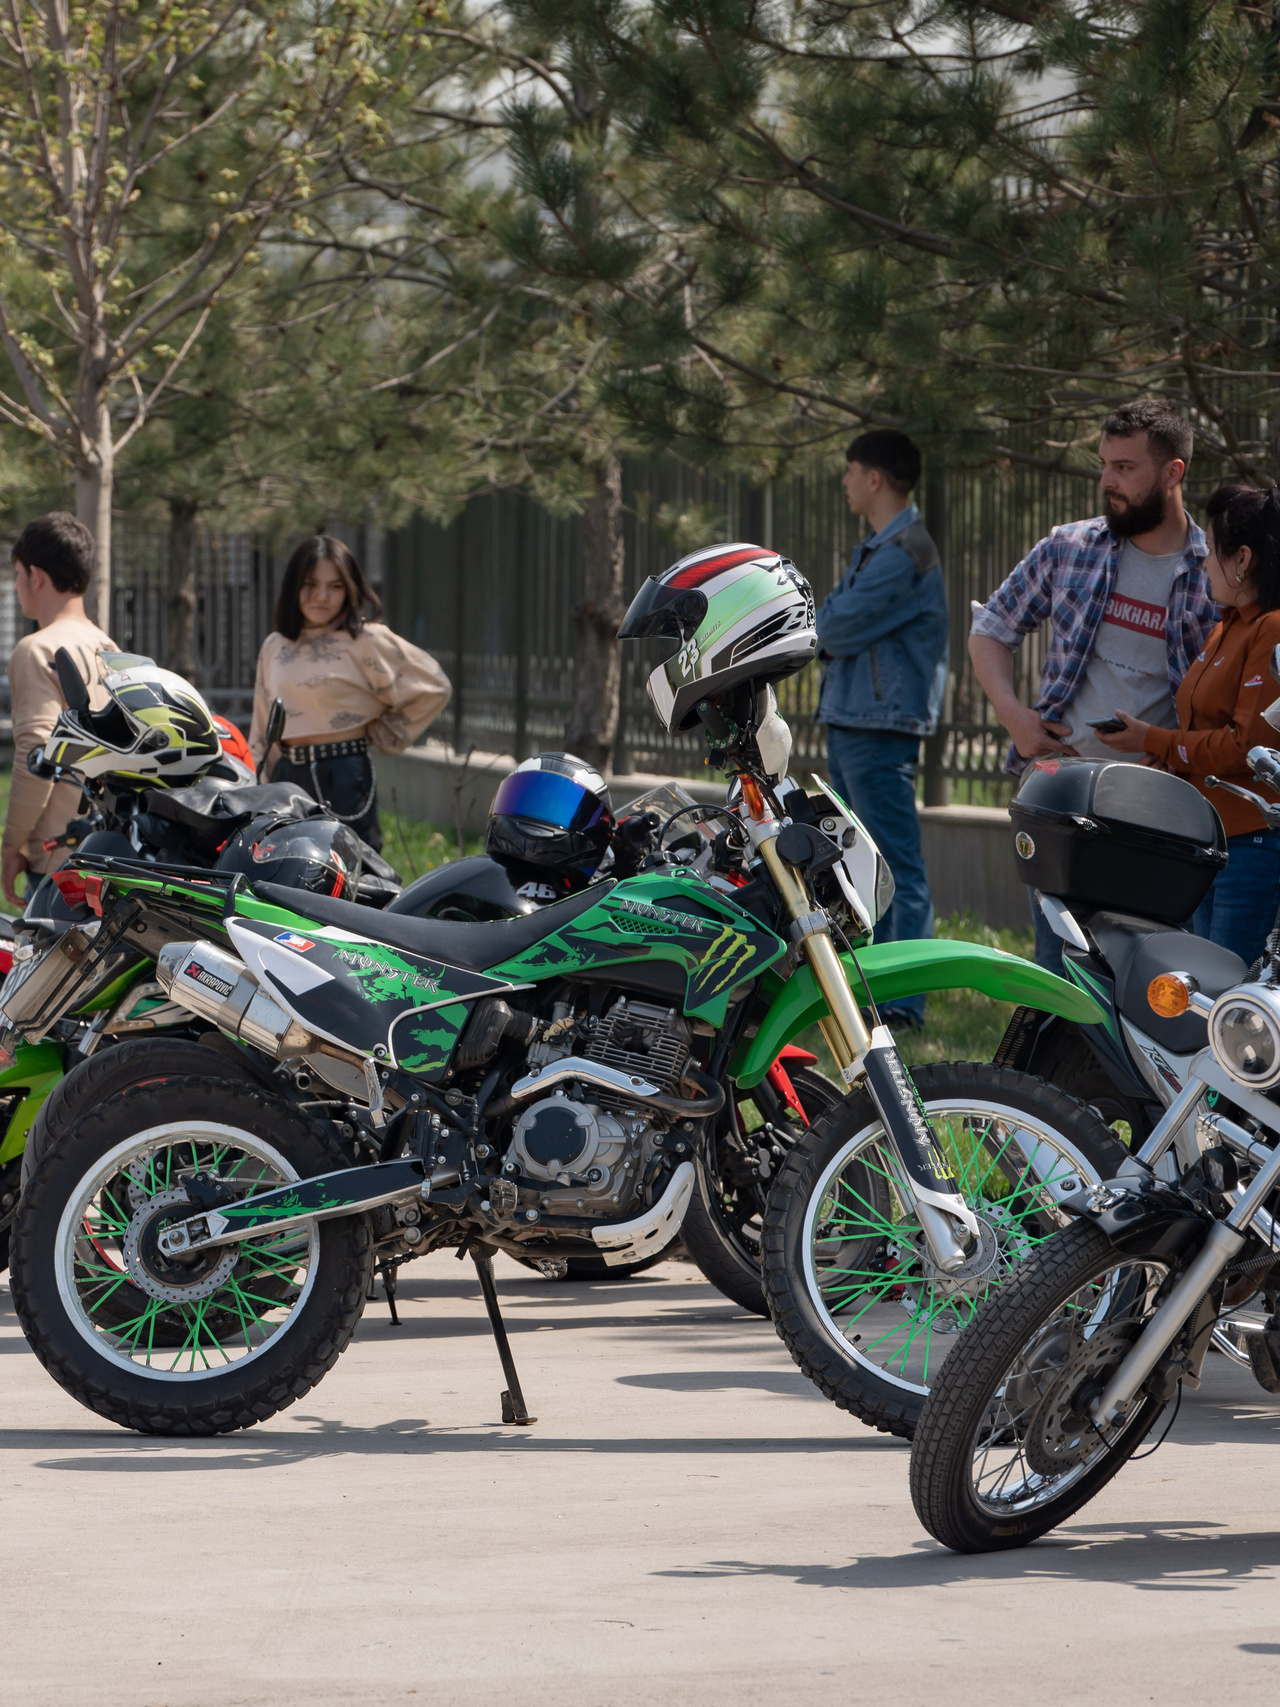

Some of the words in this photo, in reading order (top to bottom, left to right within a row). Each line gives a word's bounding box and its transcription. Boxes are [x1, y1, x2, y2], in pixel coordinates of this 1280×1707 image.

[678, 638, 700, 678] 23
[515, 881, 556, 899] 46
[620, 899, 705, 933] MONSTER
[339, 949, 439, 994] MONSTER
